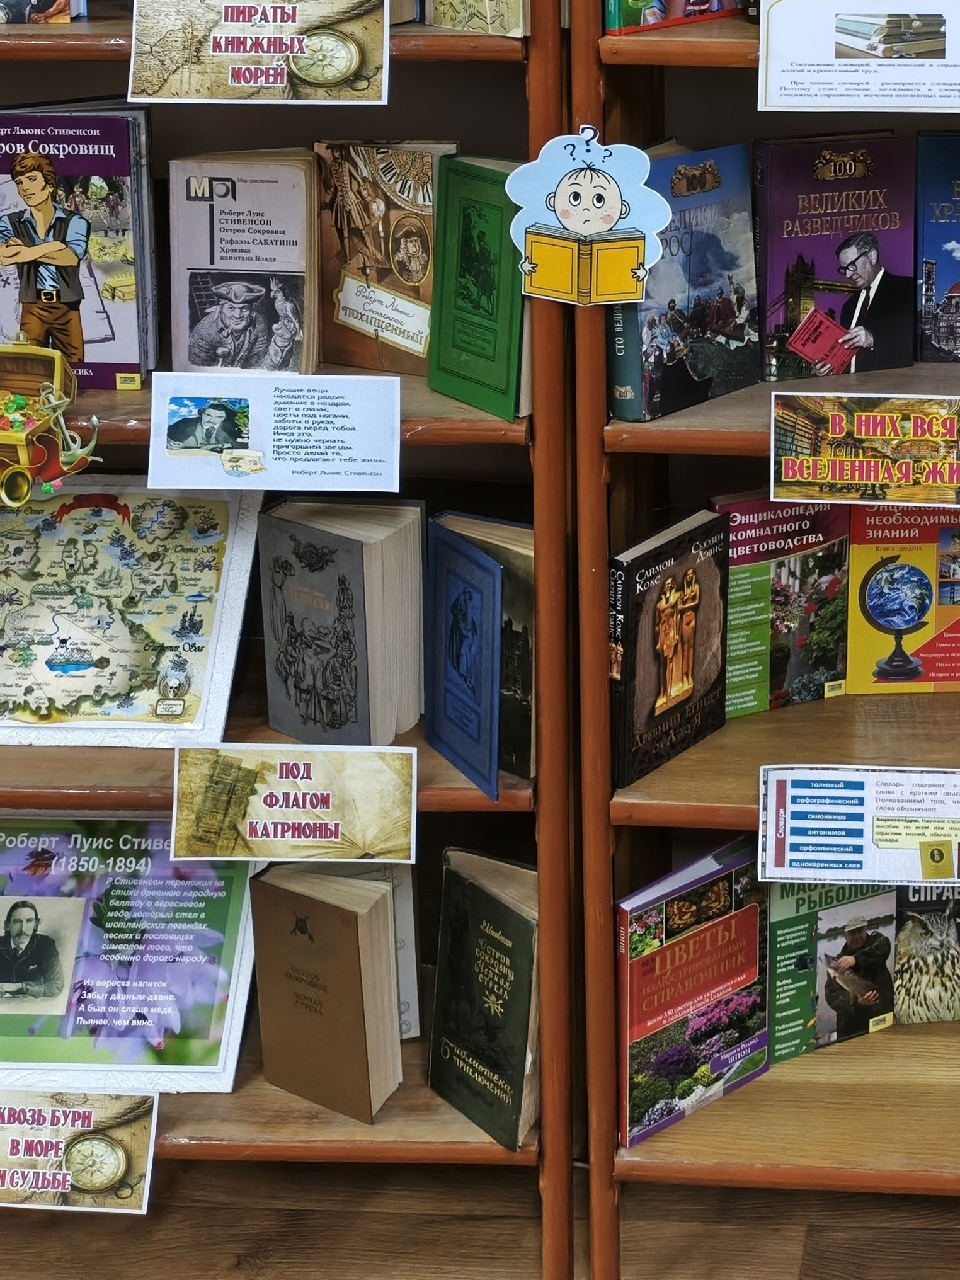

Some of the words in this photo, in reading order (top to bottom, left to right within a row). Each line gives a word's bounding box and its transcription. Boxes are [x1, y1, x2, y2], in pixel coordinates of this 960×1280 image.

[223, 5, 297, 25] ПИРАТЫ
[211, 35, 307, 55] КНИЖНЫХ
[230, 63, 287, 86] МОРЕЙ
[47, 127, 101, 137] Стивенсон
[28, 138, 116, 158] Сокровищ
[829, 161, 856, 176] 100
[797, 188, 888, 216] ВЕЛИКИХ
[218, 218, 272, 227] СТИВЕНСОН
[219, 210, 245, 218] Роберт
[219, 227, 245, 235] Остров
[247, 227, 286, 236] Сокровищ
[782, 211, 900, 239] РАЗВЕДЧИКОВ
[251, 238, 298, 247] САБАТИНИ
[829, 413, 845, 437] В
[854, 413, 901, 438] НИХ
[912, 415, 957, 439] ВСЯ
[782, 457, 913, 484] ВСЕЛЕННАЯ
[278, 762, 312, 780] ПОД
[262, 791, 332, 810] ФЛАГОМ
[248, 821, 341, 840] КАТРИОНЫ
[67, 834, 113, 851] Луис
[51, 856, 152, 875] (1850-1894)
[654, 919, 739, 977] ЦВЕТЫ
[49, 1109, 93, 1128] БУРИ
[9, 1139, 20, 1157] В
[23, 1139, 63, 1158] МОРЕ
[9, 1170, 71, 1191] СУДЬБЕ
